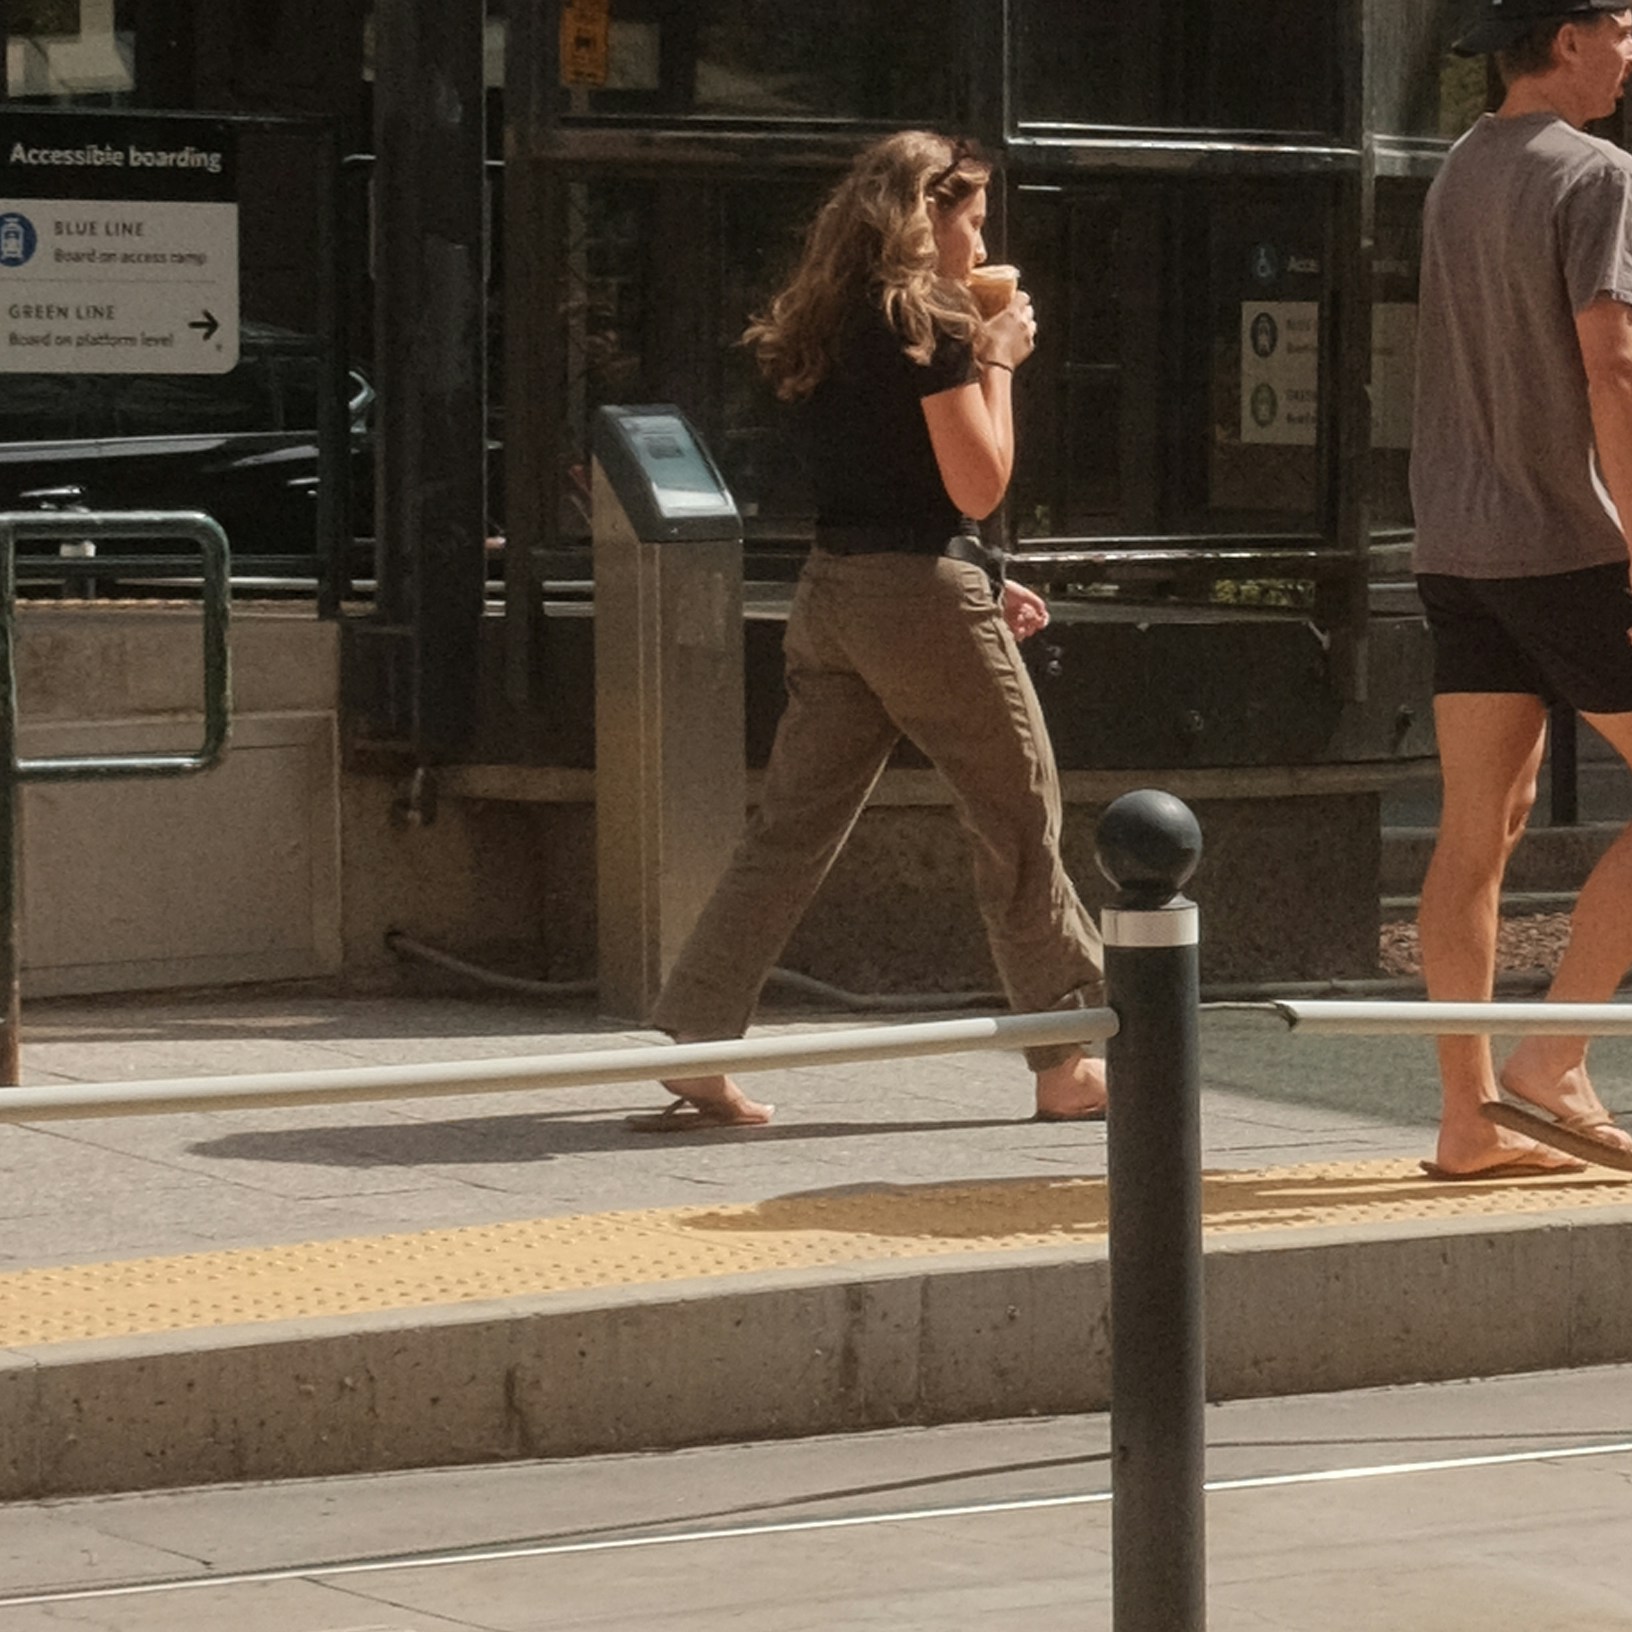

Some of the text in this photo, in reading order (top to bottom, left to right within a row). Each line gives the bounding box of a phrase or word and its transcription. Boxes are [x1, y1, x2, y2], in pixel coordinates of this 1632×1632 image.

[10, 142, 222, 173] Accessible boarding
[54, 221, 145, 237] BLUE LINE
[54, 248, 96, 263] Board
[120, 252, 167, 264] access
[8, 304, 115, 320] GREEN LINE
[9, 332, 51, 346] Board
[55, 334, 72, 346] on
[141, 332, 174, 346] level
